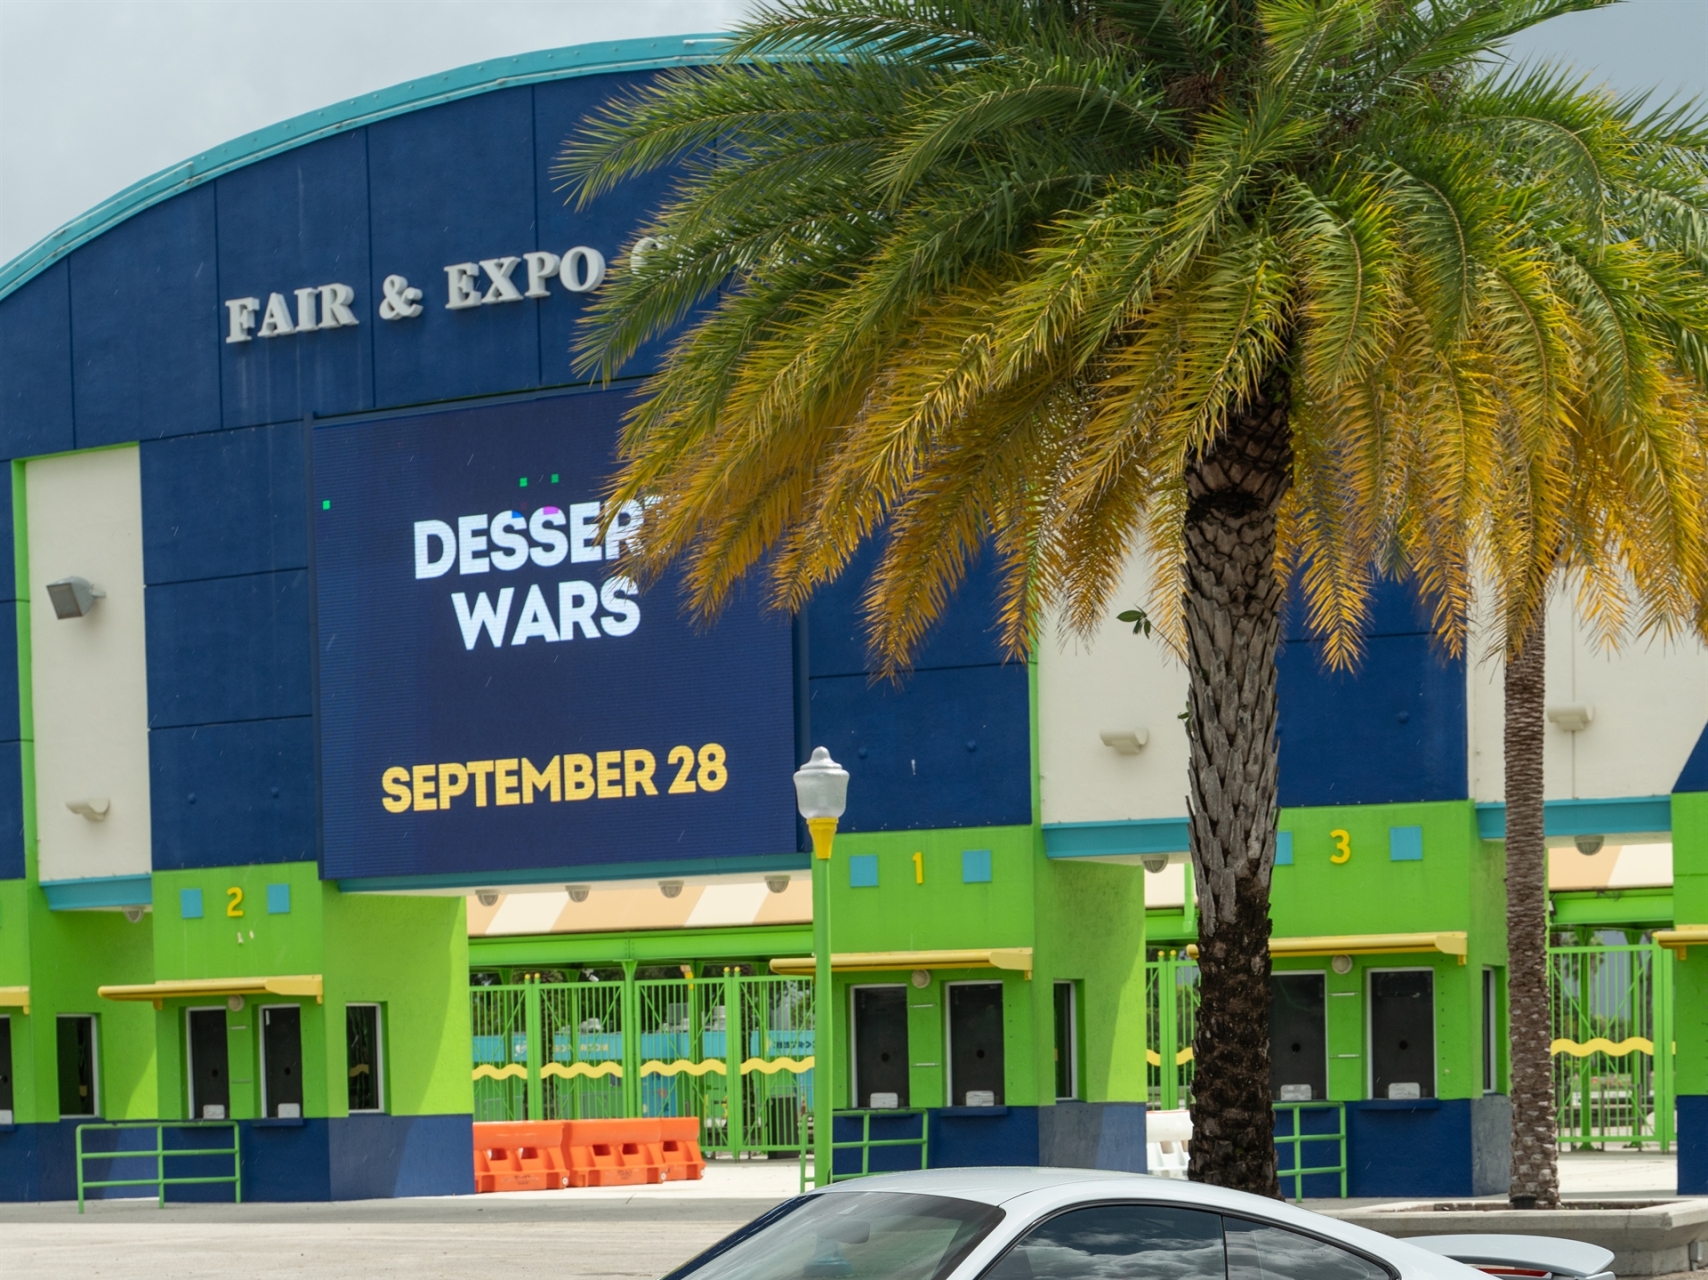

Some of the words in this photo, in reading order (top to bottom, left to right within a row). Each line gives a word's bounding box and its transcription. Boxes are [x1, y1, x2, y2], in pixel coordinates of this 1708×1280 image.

[225, 283, 359, 344] FAIR
[379, 273, 424, 321] &
[443, 245, 606, 310] EXPO
[451, 576, 641, 650] WARS
[382, 749, 659, 813] SEPTEMBER
[667, 743, 728, 795] 28
[912, 852, 923, 884] 1
[1329, 829, 1351, 865] 3
[226, 886, 244, 918] 2
